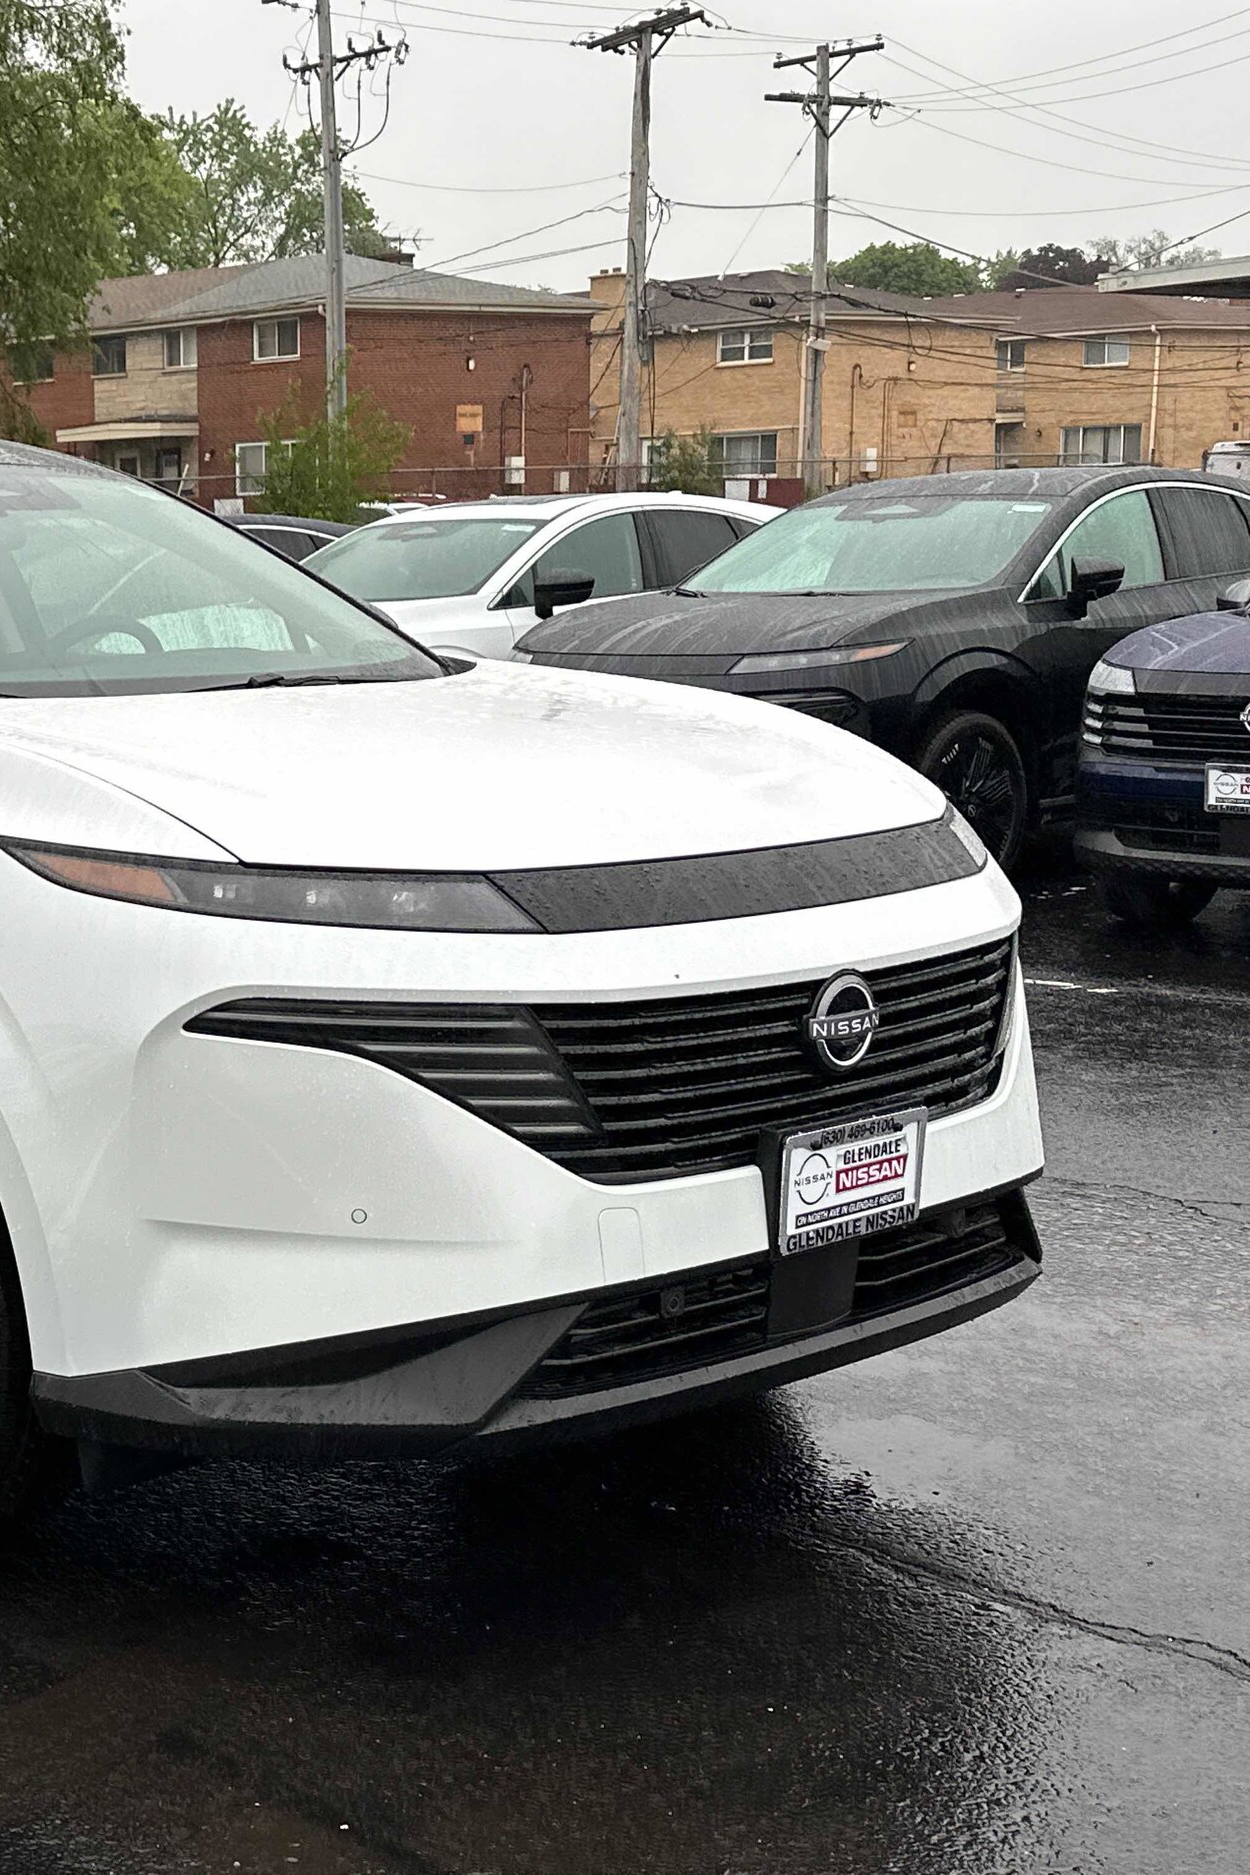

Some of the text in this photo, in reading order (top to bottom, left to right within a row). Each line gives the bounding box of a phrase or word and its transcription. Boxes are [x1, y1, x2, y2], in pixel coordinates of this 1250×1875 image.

[812, 1012, 879, 1037] NISSAN
[821, 1117, 895, 1148] (630) 469-6100
[843, 1139, 901, 1165] GLENDALE
[794, 1171, 833, 1188] NISSAN
[838, 1158, 904, 1190] NISSAN
[787, 1204, 915, 1252] GLENDALE NISSAN
[797, 1216, 807, 1226] ON
